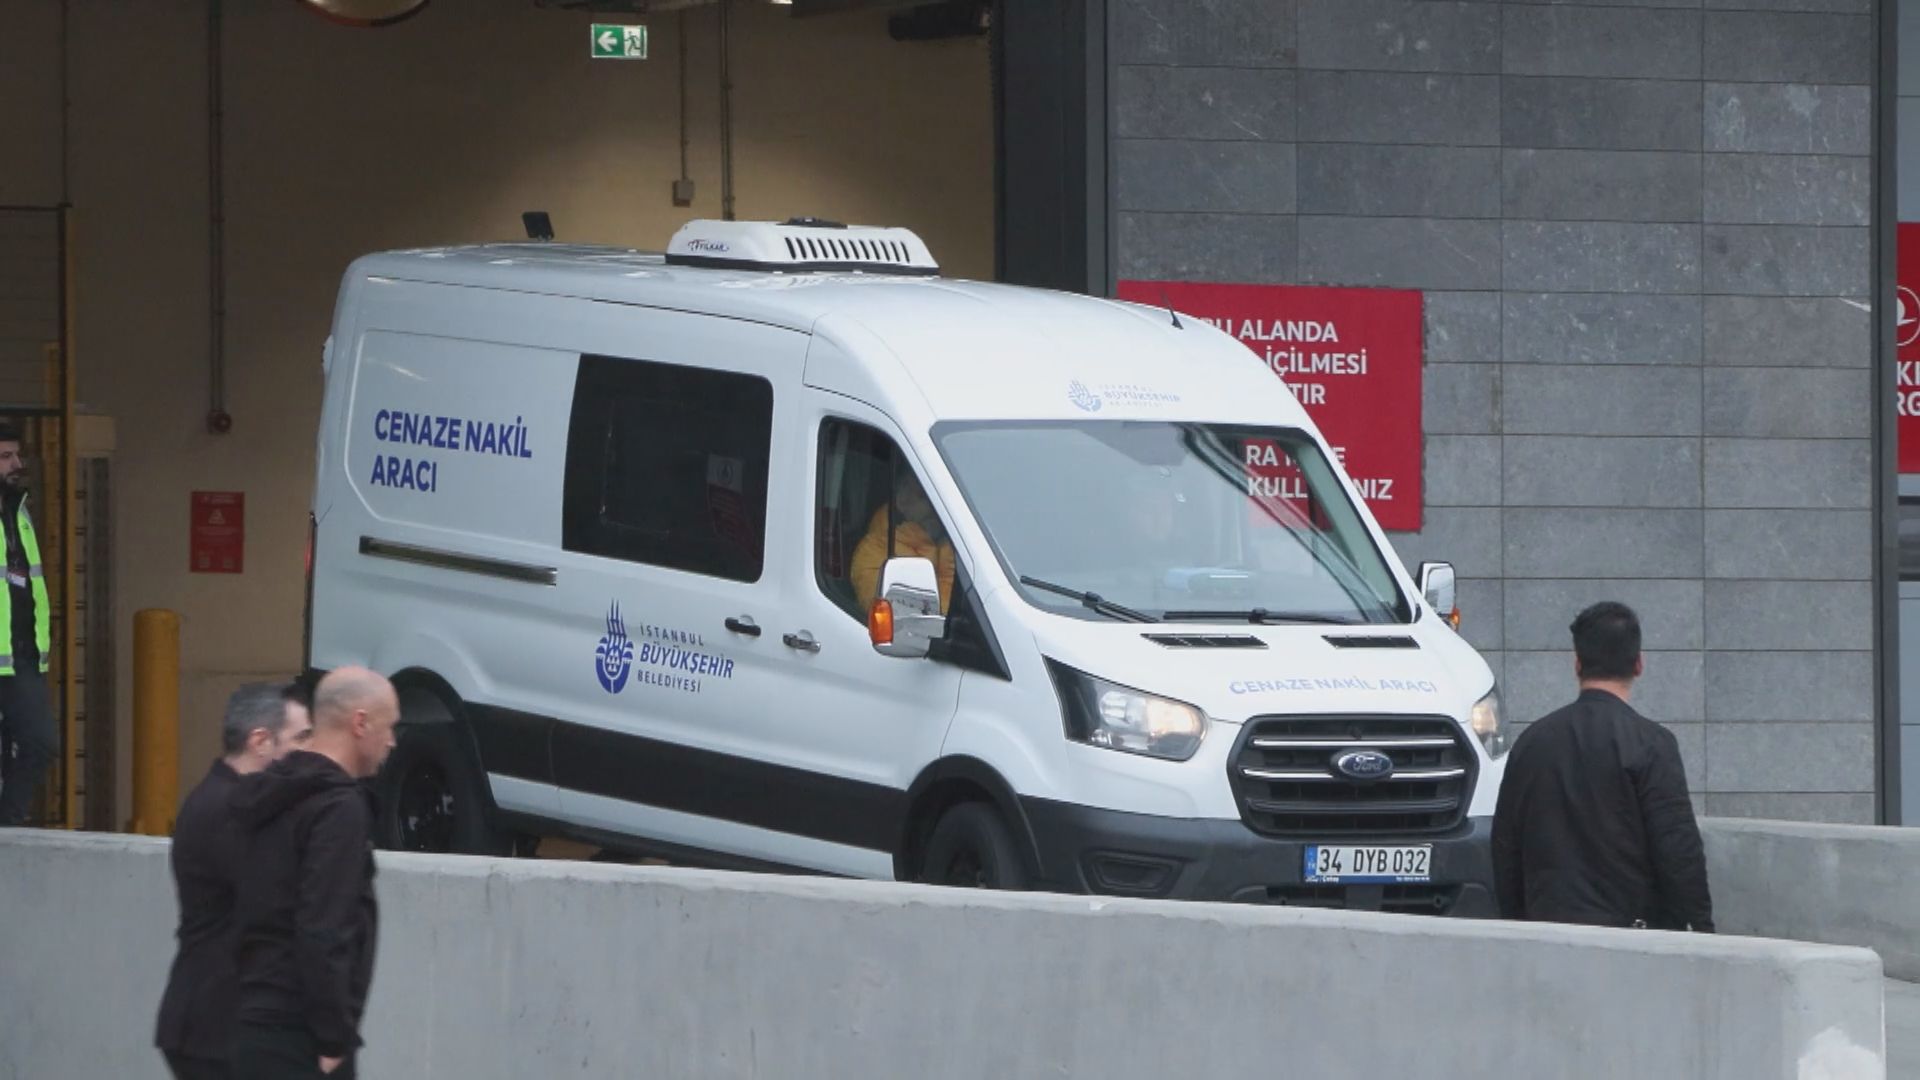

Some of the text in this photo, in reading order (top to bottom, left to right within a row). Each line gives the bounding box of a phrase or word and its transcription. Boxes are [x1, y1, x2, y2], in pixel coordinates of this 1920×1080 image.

[1238, 319, 1339, 342] ALANDA
[1265, 345, 1368, 377] İÇİLMESİ
[1287, 382, 1326, 405] TIR
[375, 409, 532, 458] CENAZE NAKİL
[370, 455, 437, 493] ARACI
[640, 622, 704, 647] İSTANBUL
[640, 642, 734, 680] BÜYÜKŞEHİR
[637, 669, 702, 693] BELEDİYESİ
[1229, 675, 1438, 695] CENAZE NAKİL ARACI
[1353, 755, 1383, 771] Ford
[1319, 848, 1342, 873] 34
[1353, 849, 1388, 873] DYB
[1393, 850, 1427, 873] 032
